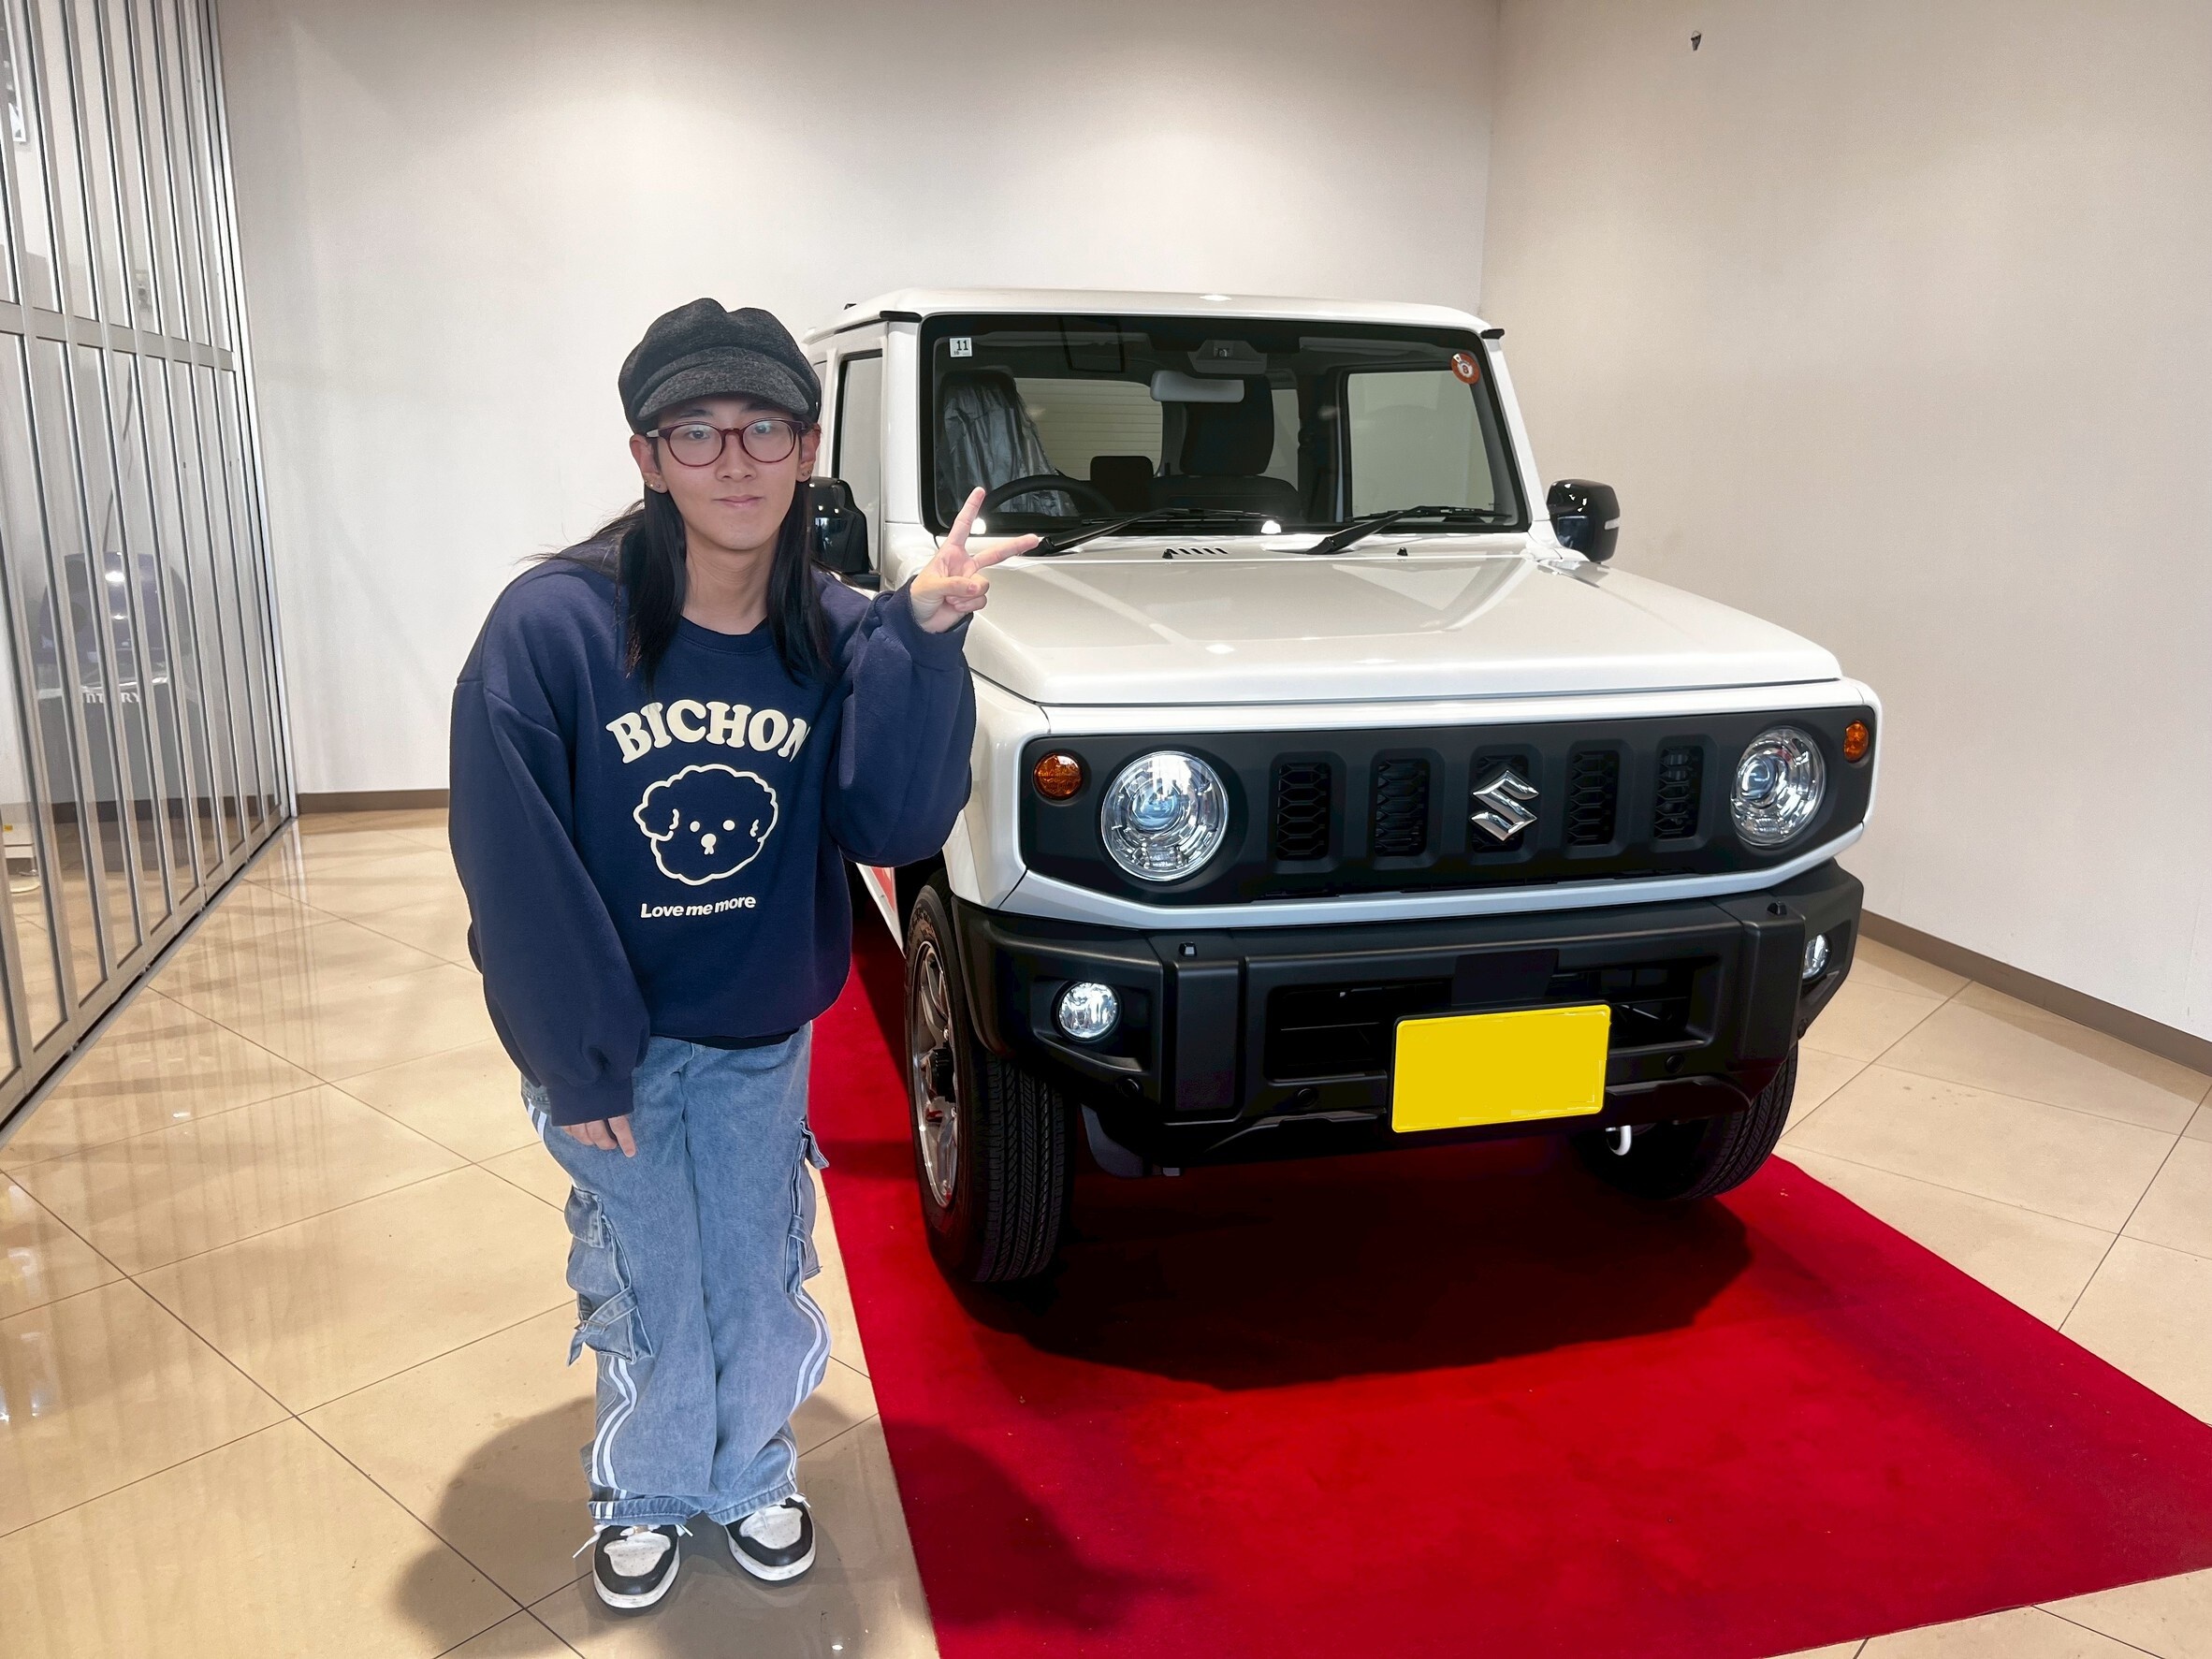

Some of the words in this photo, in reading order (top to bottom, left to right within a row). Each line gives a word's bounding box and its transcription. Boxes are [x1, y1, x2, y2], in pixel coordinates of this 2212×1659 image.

[956, 340, 968, 351] 11
[640, 903, 685, 919] Love
[685, 904, 713, 917] me
[714, 895, 757, 913] more
